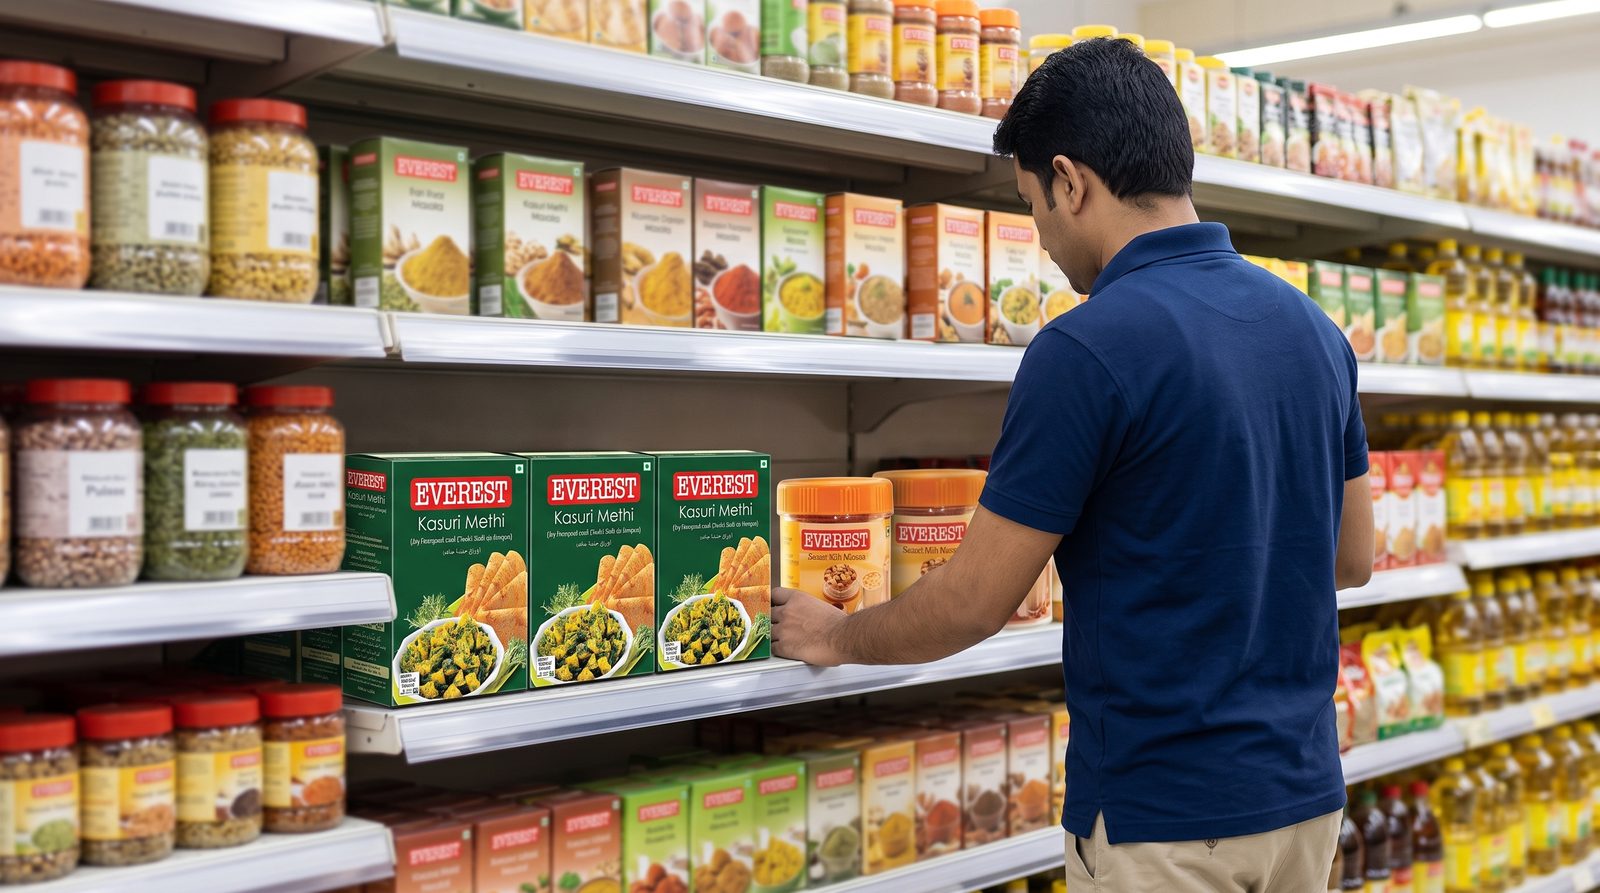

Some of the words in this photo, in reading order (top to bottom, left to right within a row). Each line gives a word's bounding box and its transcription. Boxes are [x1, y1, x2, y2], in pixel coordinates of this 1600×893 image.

[397, 157, 456, 181] EVEREST
[518, 172, 571, 193] EVEREST
[633, 186, 682, 206] EVEREST
[347, 471, 385, 490] EVEREST
[551, 477, 637, 501] EVEREST
[676, 474, 755, 497] EVEREST
[415, 480, 508, 506] EVEREST
[554, 509, 593, 525] Kasuri
[597, 507, 634, 523] Methi
[679, 504, 715, 519] Kasuri
[719, 502, 753, 517] Methi
[418, 514, 461, 532] Kasuri
[465, 513, 506, 530] Methi
[804, 532, 868, 548] EVEREST
[898, 525, 964, 541] EVEREST
